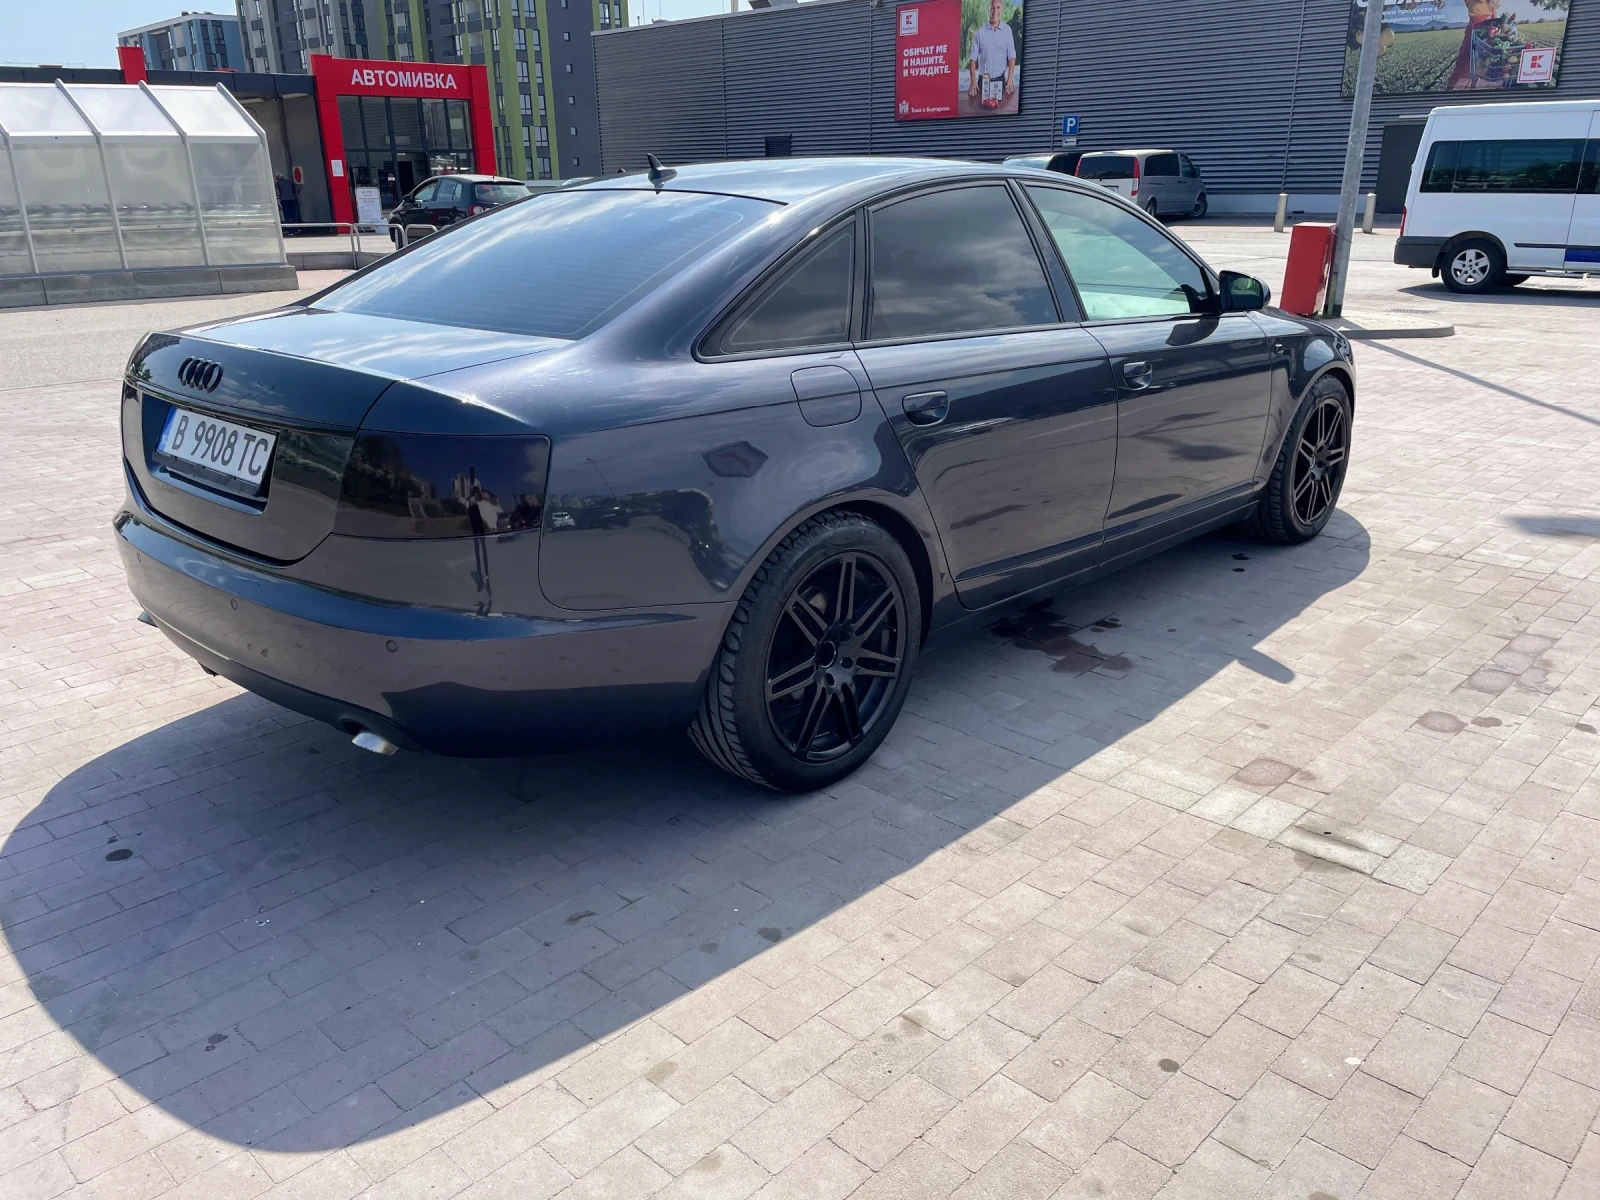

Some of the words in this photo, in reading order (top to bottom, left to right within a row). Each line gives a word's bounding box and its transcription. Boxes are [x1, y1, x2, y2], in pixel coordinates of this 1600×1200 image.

[1398, 7, 1433, 16] продукти
[903, 45, 934, 56] ОБИЧАТ
[936, 44, 947, 54] МЕ
[903, 59, 908, 67] И
[910, 56, 945, 66] НАШИТЕ,
[903, 69, 908, 77] И
[910, 65, 951, 76] ЧУЖДИТЕ.
[351, 68, 457, 90] АВТОМИВКА
[1066, 117, 1076, 133] P
[171, 415, 189, 451] B
[190, 420, 238, 467] 9908
[237, 433, 269, 476] TC
